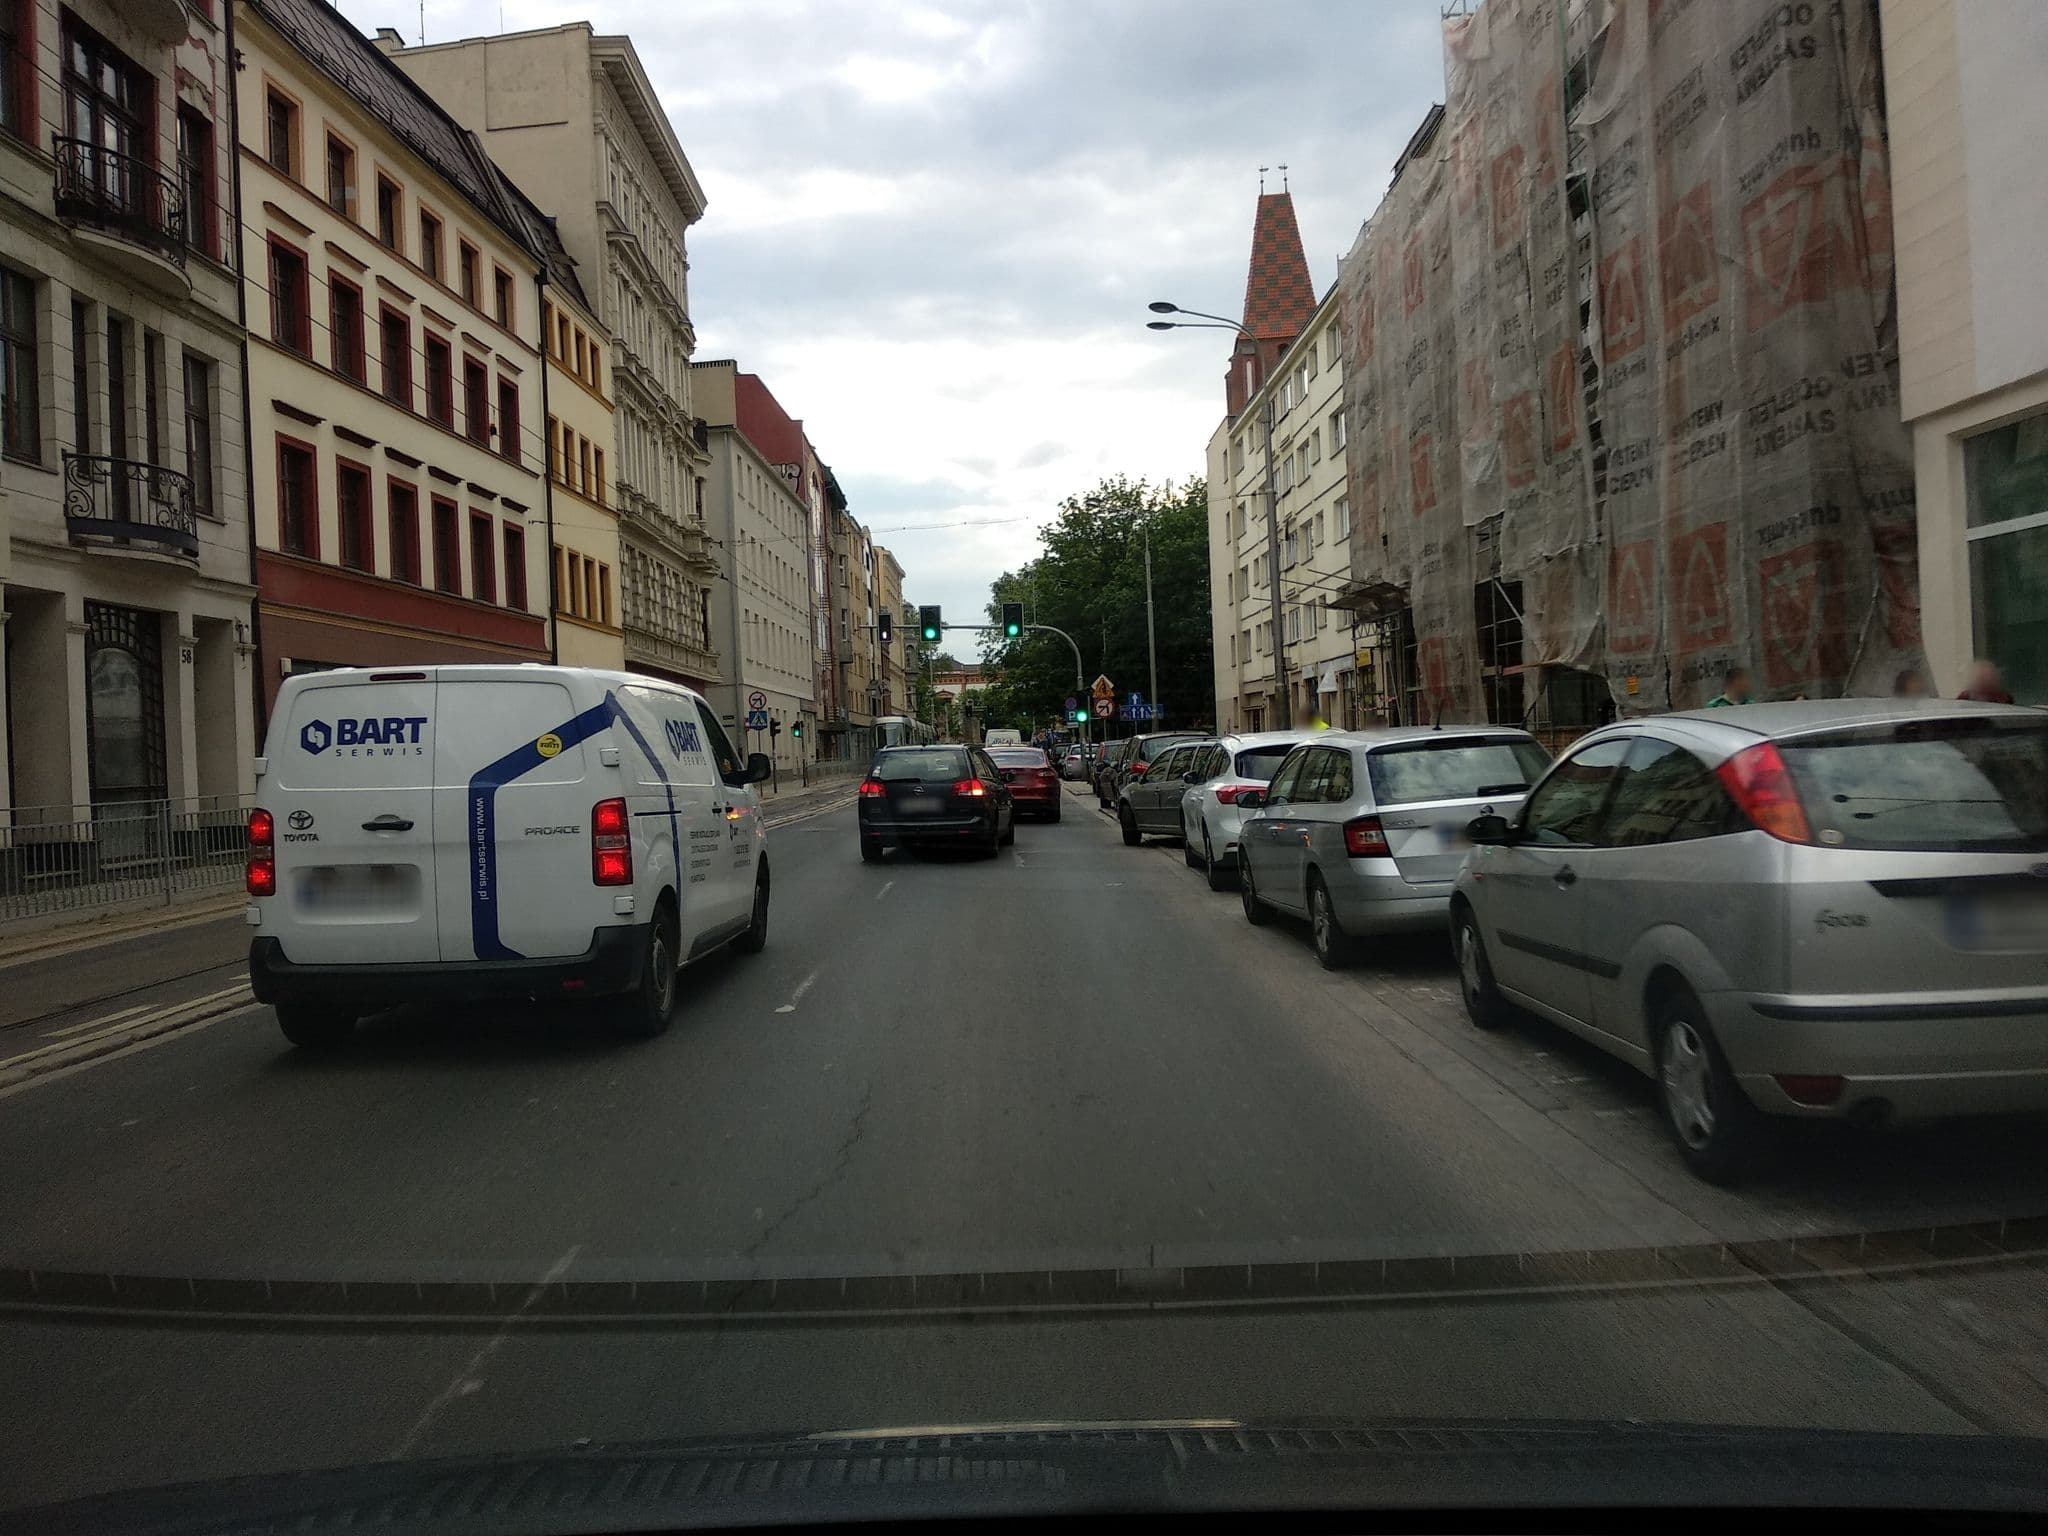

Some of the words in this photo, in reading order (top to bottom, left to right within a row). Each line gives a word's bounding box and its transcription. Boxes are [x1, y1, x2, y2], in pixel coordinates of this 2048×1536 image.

[181, 649, 192, 664] 58
[336, 717, 428, 746] BART
[672, 719, 702, 753] BART
[335, 747, 424, 757] SERWIS
[283, 833, 320, 843] TOYOTA
[524, 825, 582, 836] PROACE
[475, 797, 490, 901] www.bartserwis.pl
